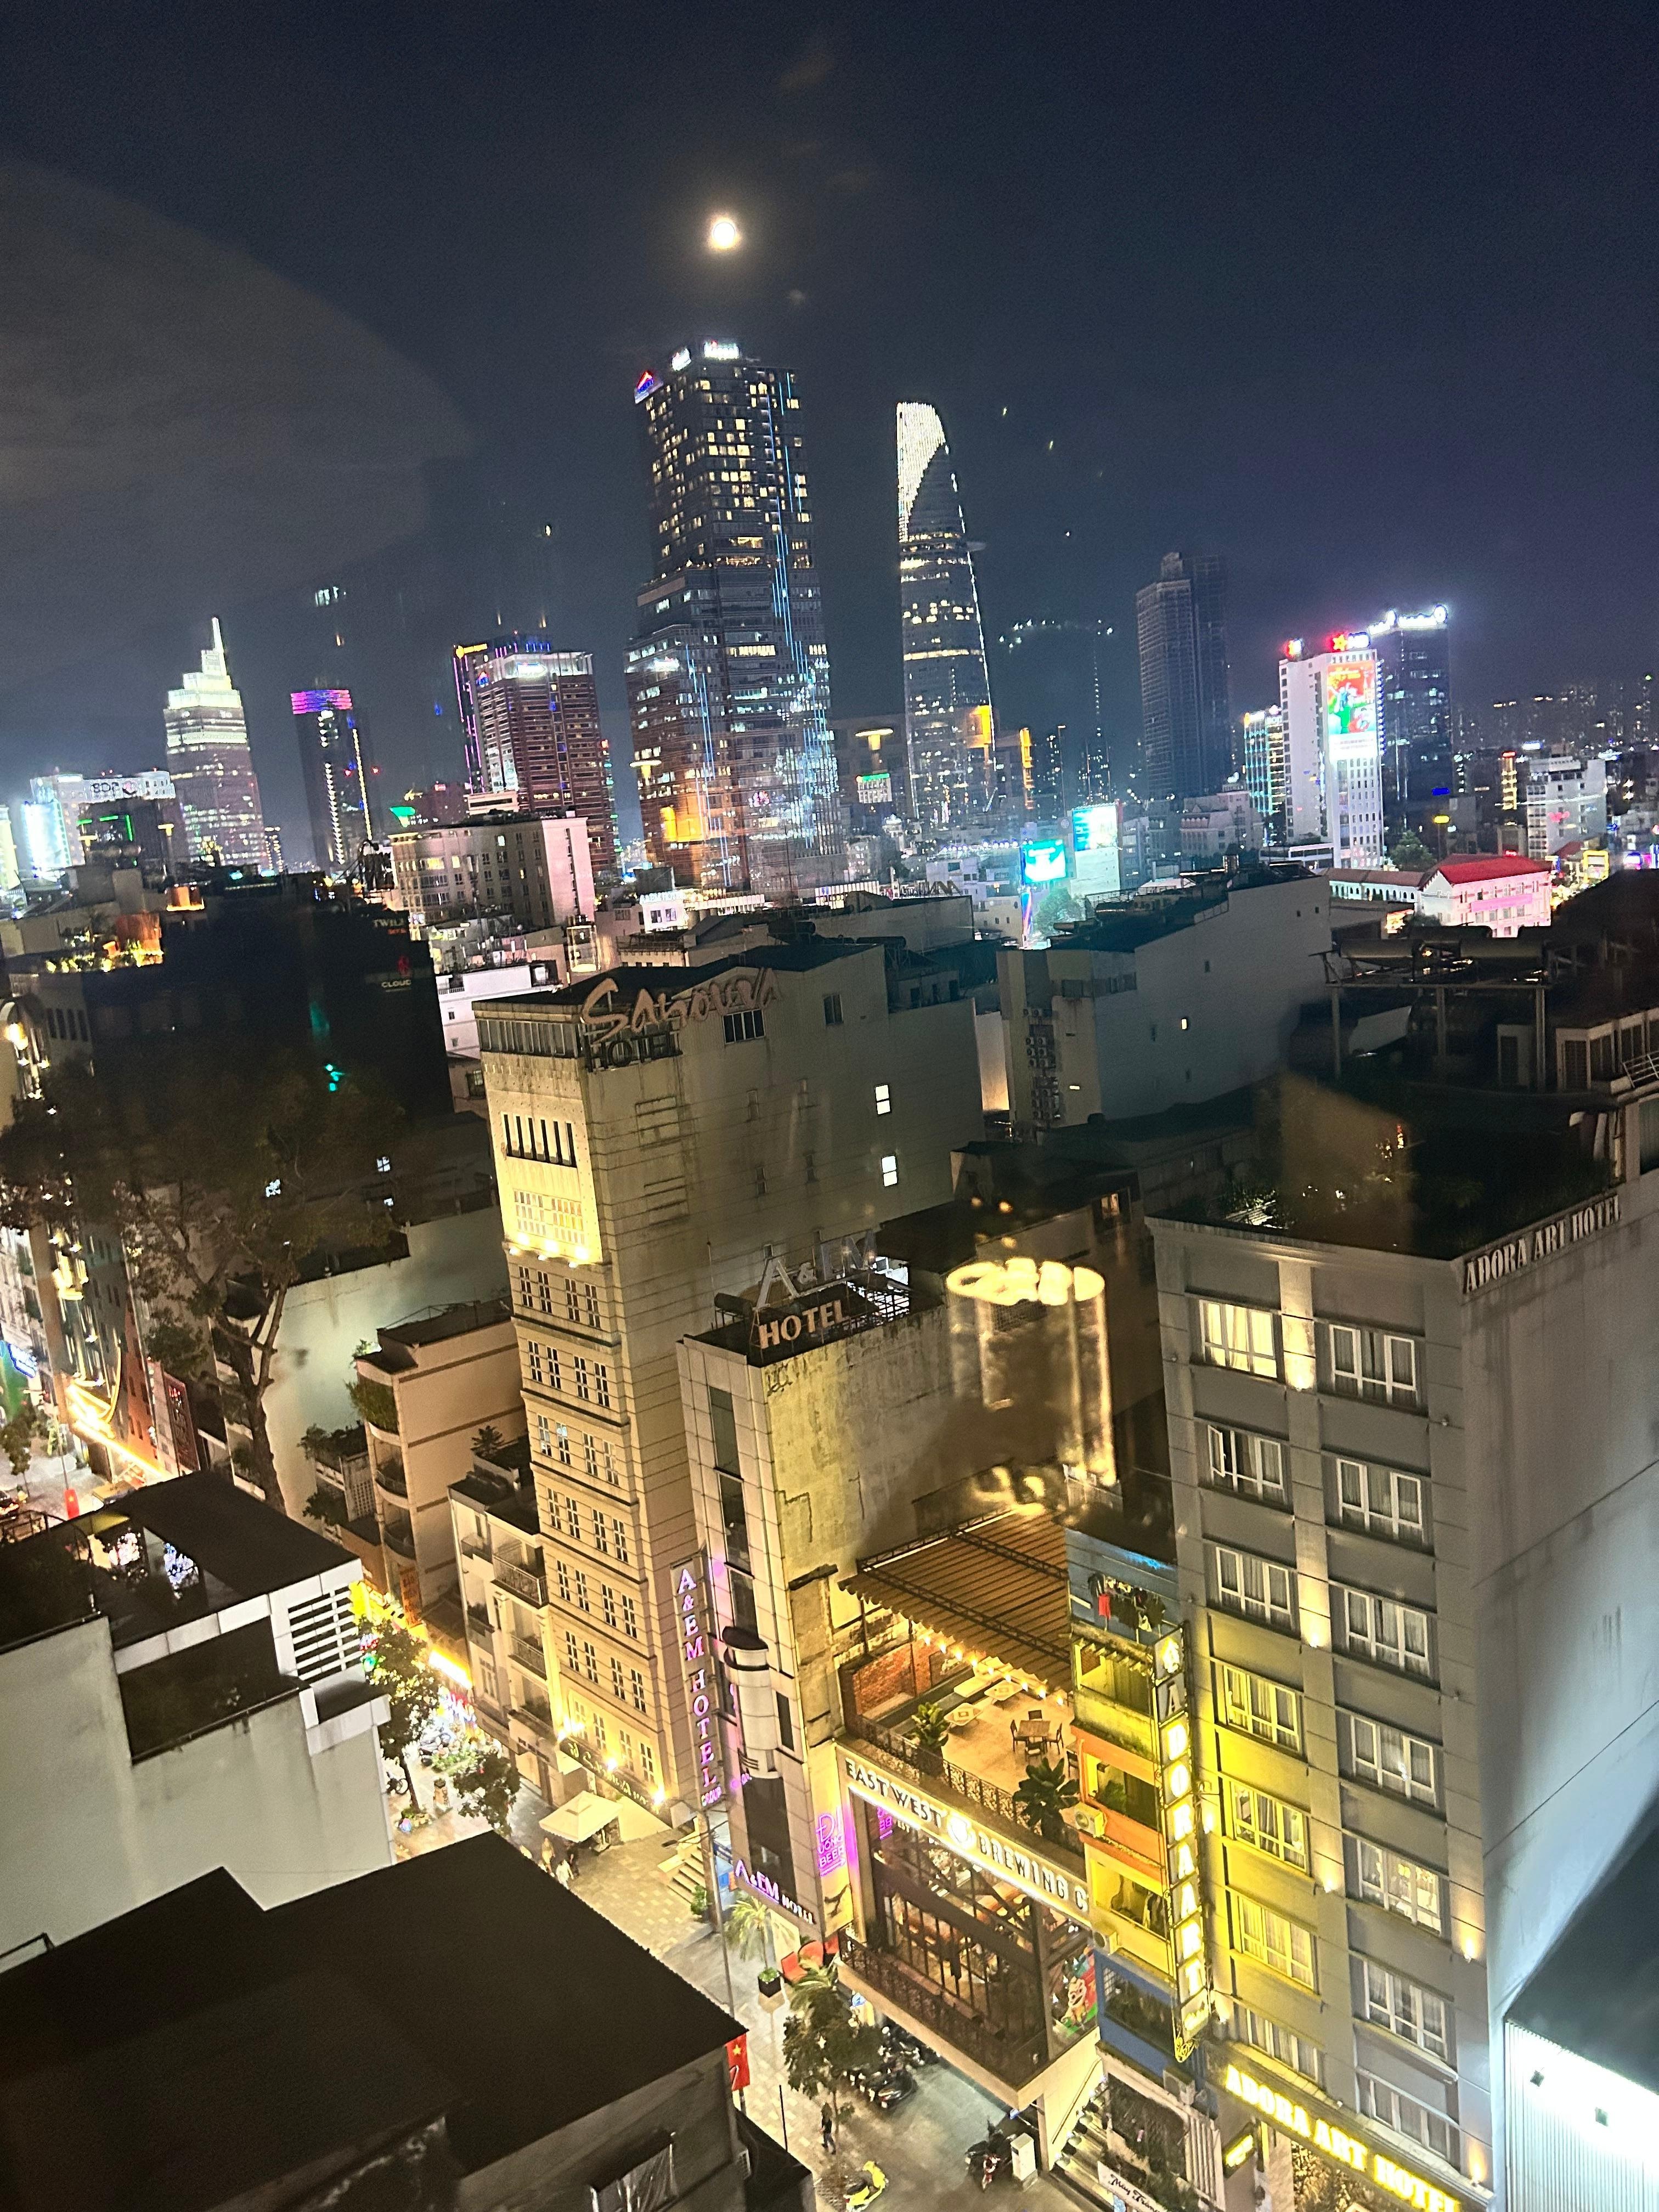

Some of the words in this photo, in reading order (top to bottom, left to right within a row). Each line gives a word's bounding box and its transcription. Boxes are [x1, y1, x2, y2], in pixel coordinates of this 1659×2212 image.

[584, 1031, 684, 1073] HOTEL
[1464, 1238, 1528, 1294] ADORA
[1533, 1219, 1566, 1260] ART
[1571, 1194, 1621, 1242] HOTEL
[758, 1299, 850, 1350] HOTEL
[689, 1668, 717, 1788] HOTEL
[845, 1757, 890, 1797] EAST
[889, 1781, 948, 1829] WEST
[978, 1831, 1069, 1901] BREWING
[1225, 2064, 1312, 2138] ADORA
[1312, 2118, 1369, 2172] ART
